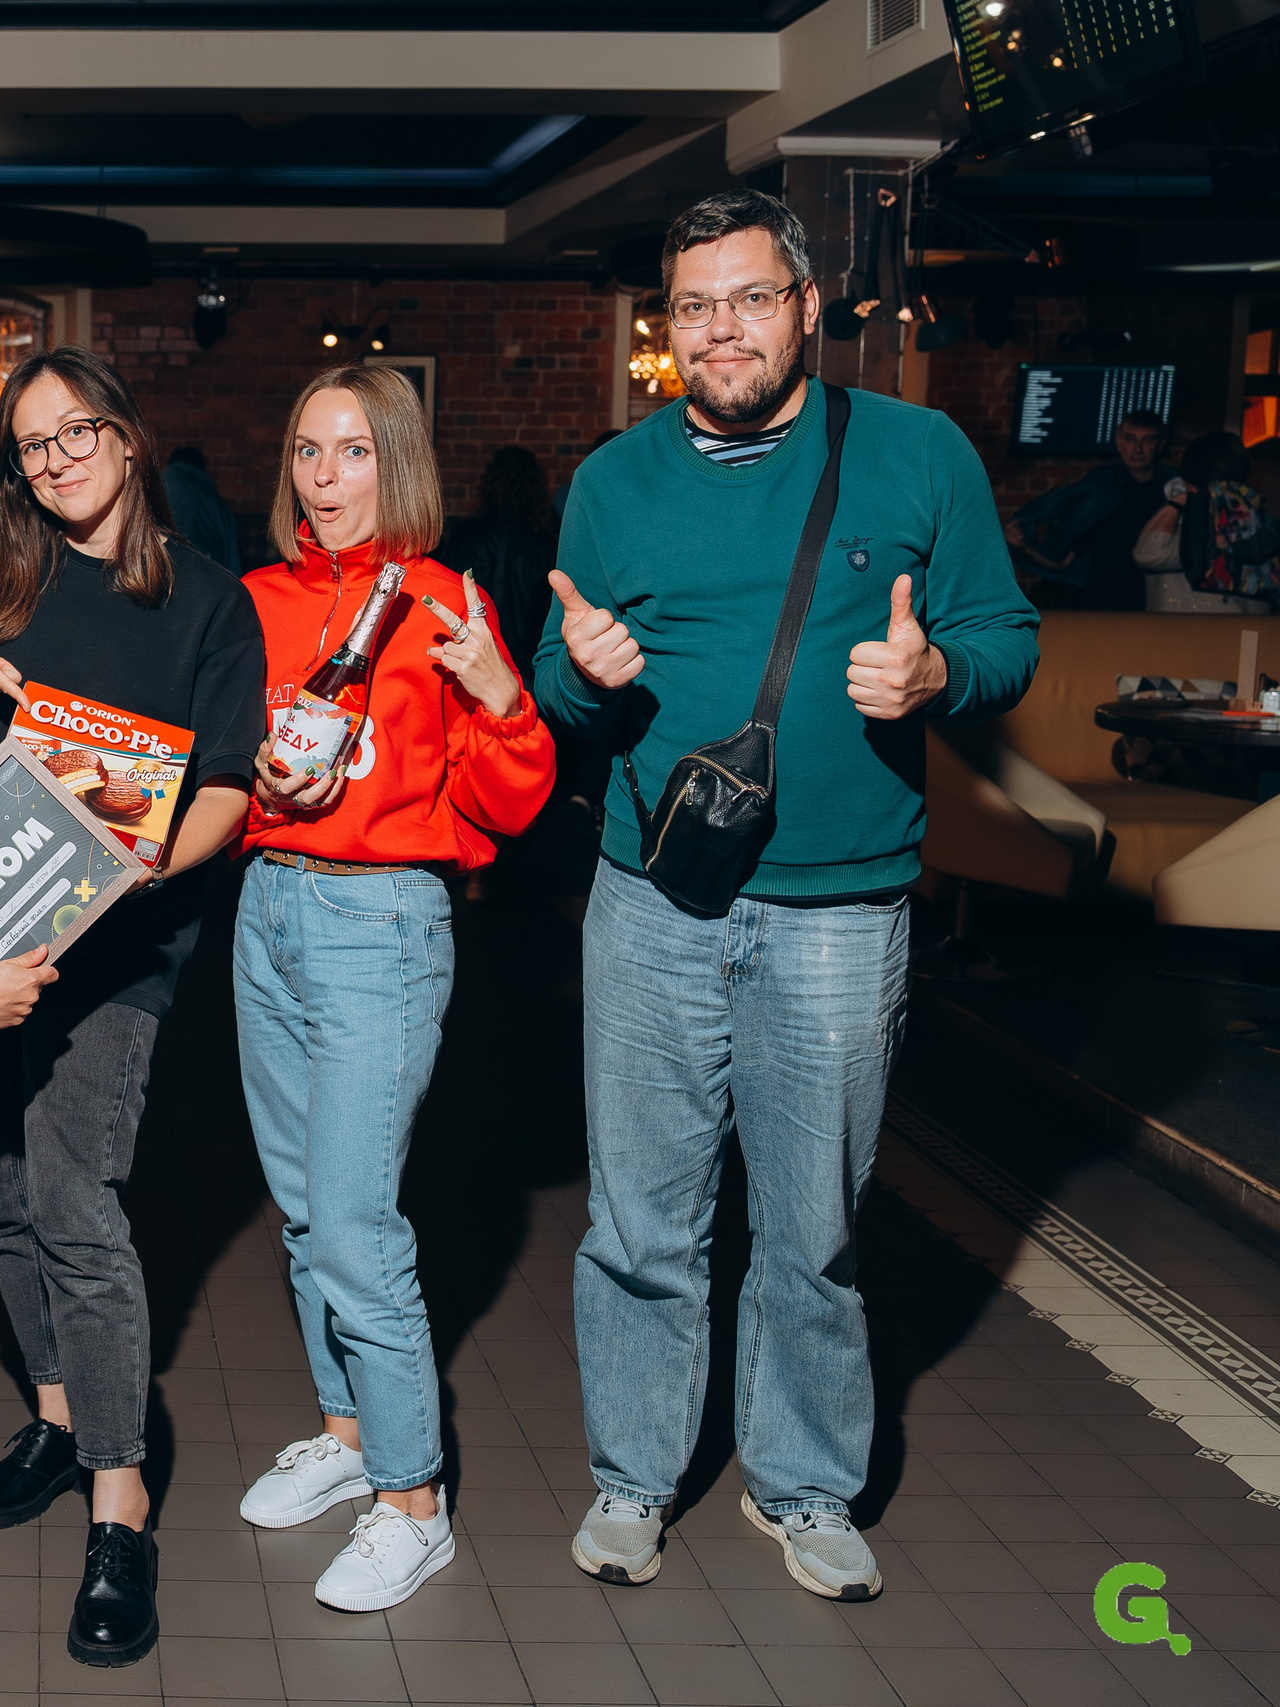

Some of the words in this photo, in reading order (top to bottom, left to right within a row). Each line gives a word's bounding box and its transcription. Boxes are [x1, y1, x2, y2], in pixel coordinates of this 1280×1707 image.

[85, 706, 133, 726] ORION
[127, 768, 178, 784] Original
[34, 870, 50, 887] игры
